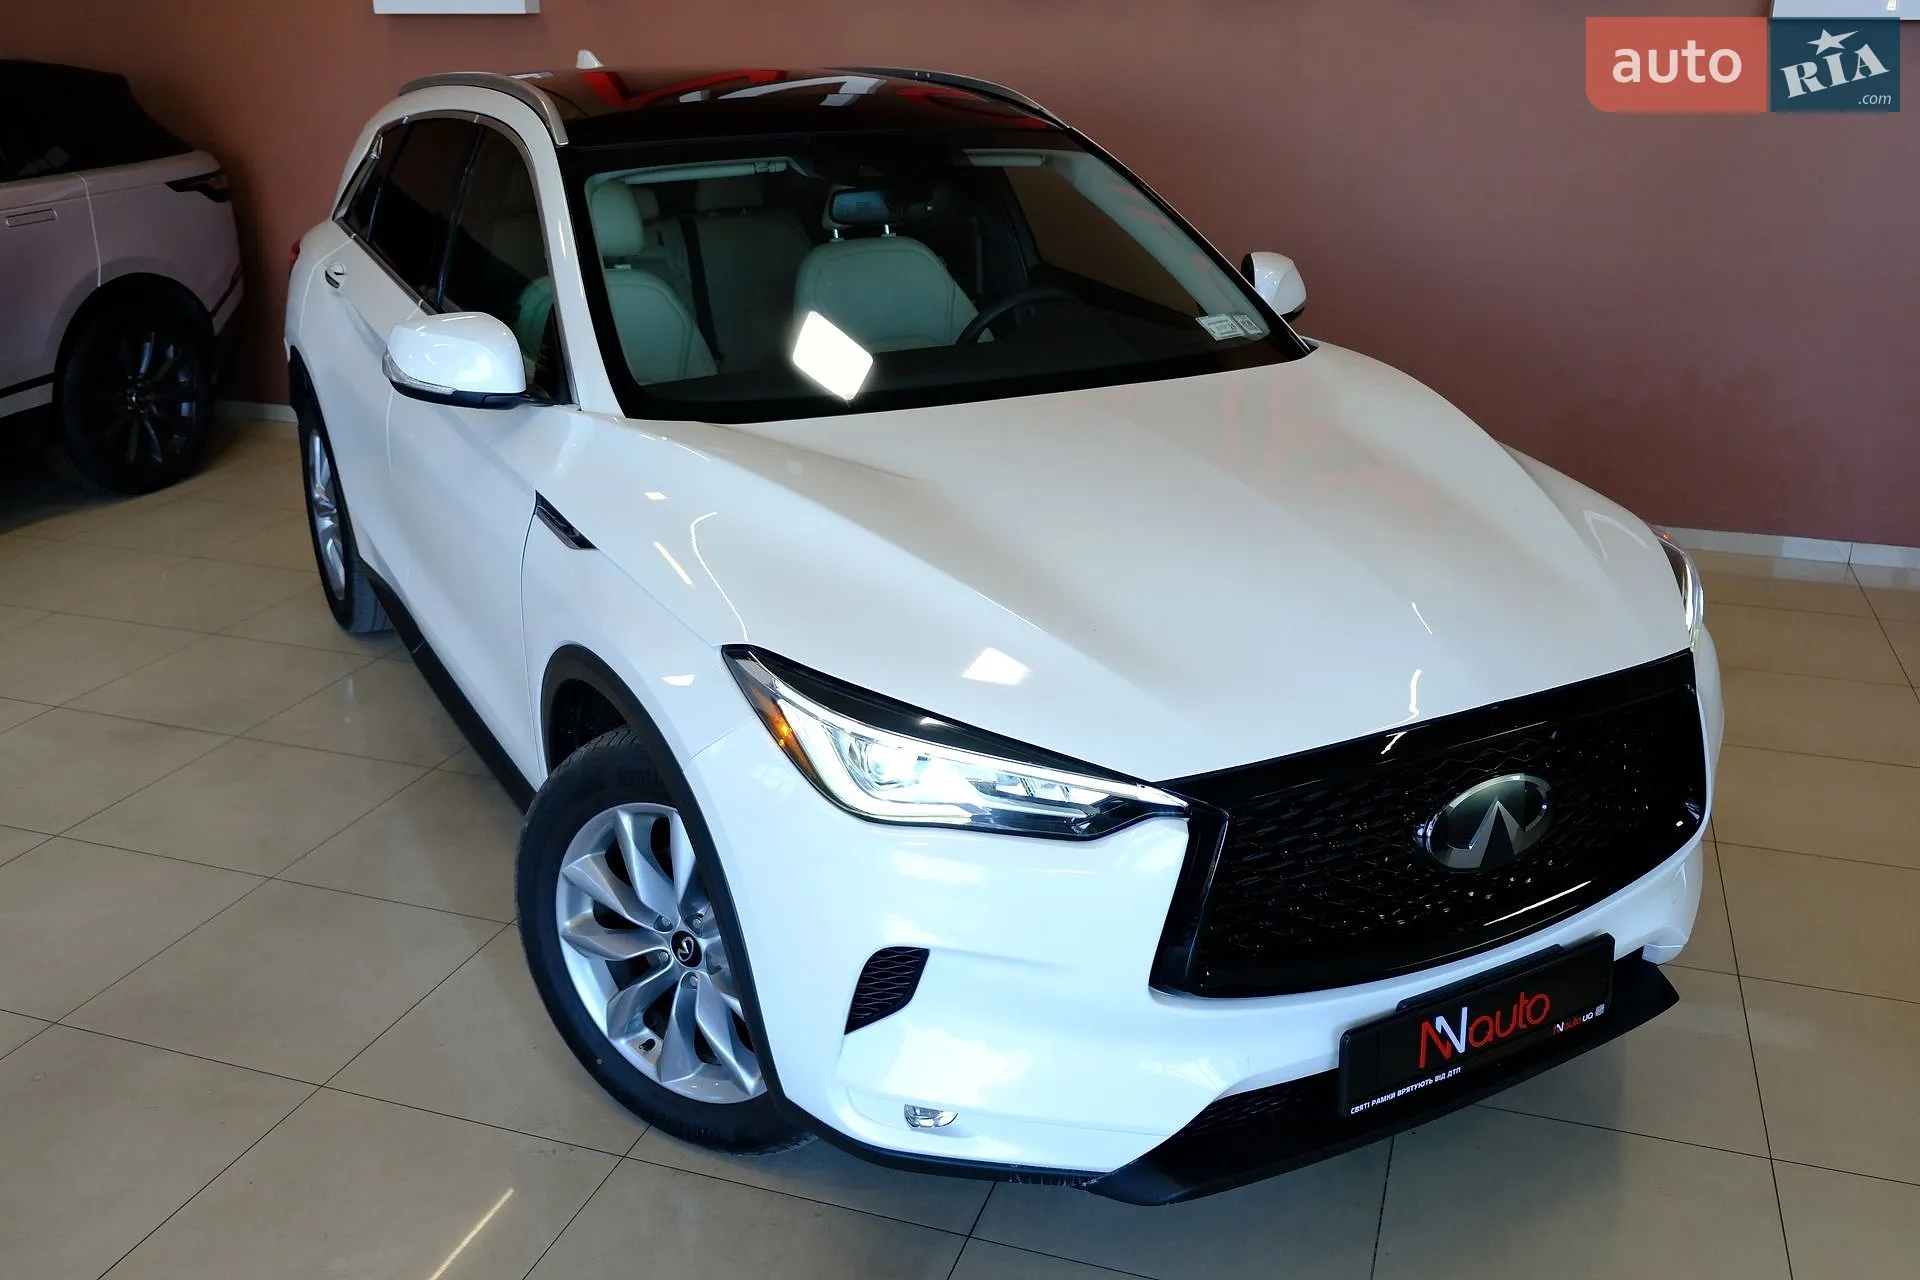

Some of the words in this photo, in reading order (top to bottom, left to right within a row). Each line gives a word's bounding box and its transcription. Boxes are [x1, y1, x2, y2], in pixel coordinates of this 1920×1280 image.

[1371, 1091, 1396, 1107] РАМКИ
[1397, 1078, 1433, 1097] ВРЯТУЮТЬ
[1447, 1066, 1461, 1079] ДТП
